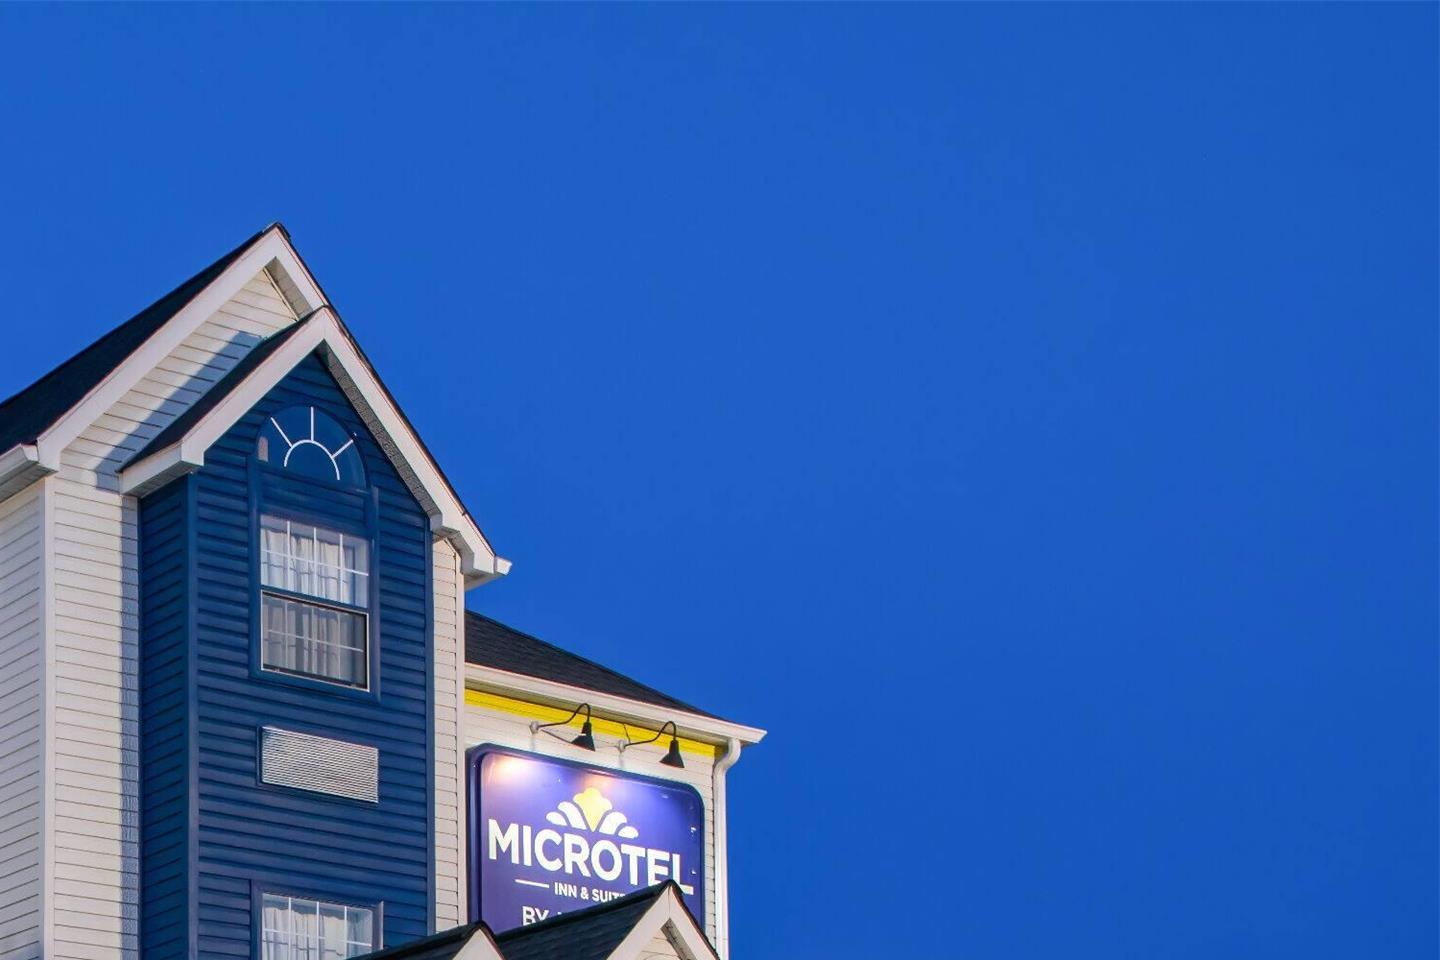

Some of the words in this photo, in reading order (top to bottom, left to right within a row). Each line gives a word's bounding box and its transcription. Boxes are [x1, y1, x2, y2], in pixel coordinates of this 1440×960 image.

[488, 818, 694, 895] MICROTEL
[554, 882, 577, 898] INN
[580, 886, 589, 900] &
[592, 888, 626, 903] SUIT
[522, 906, 549, 926] BY
